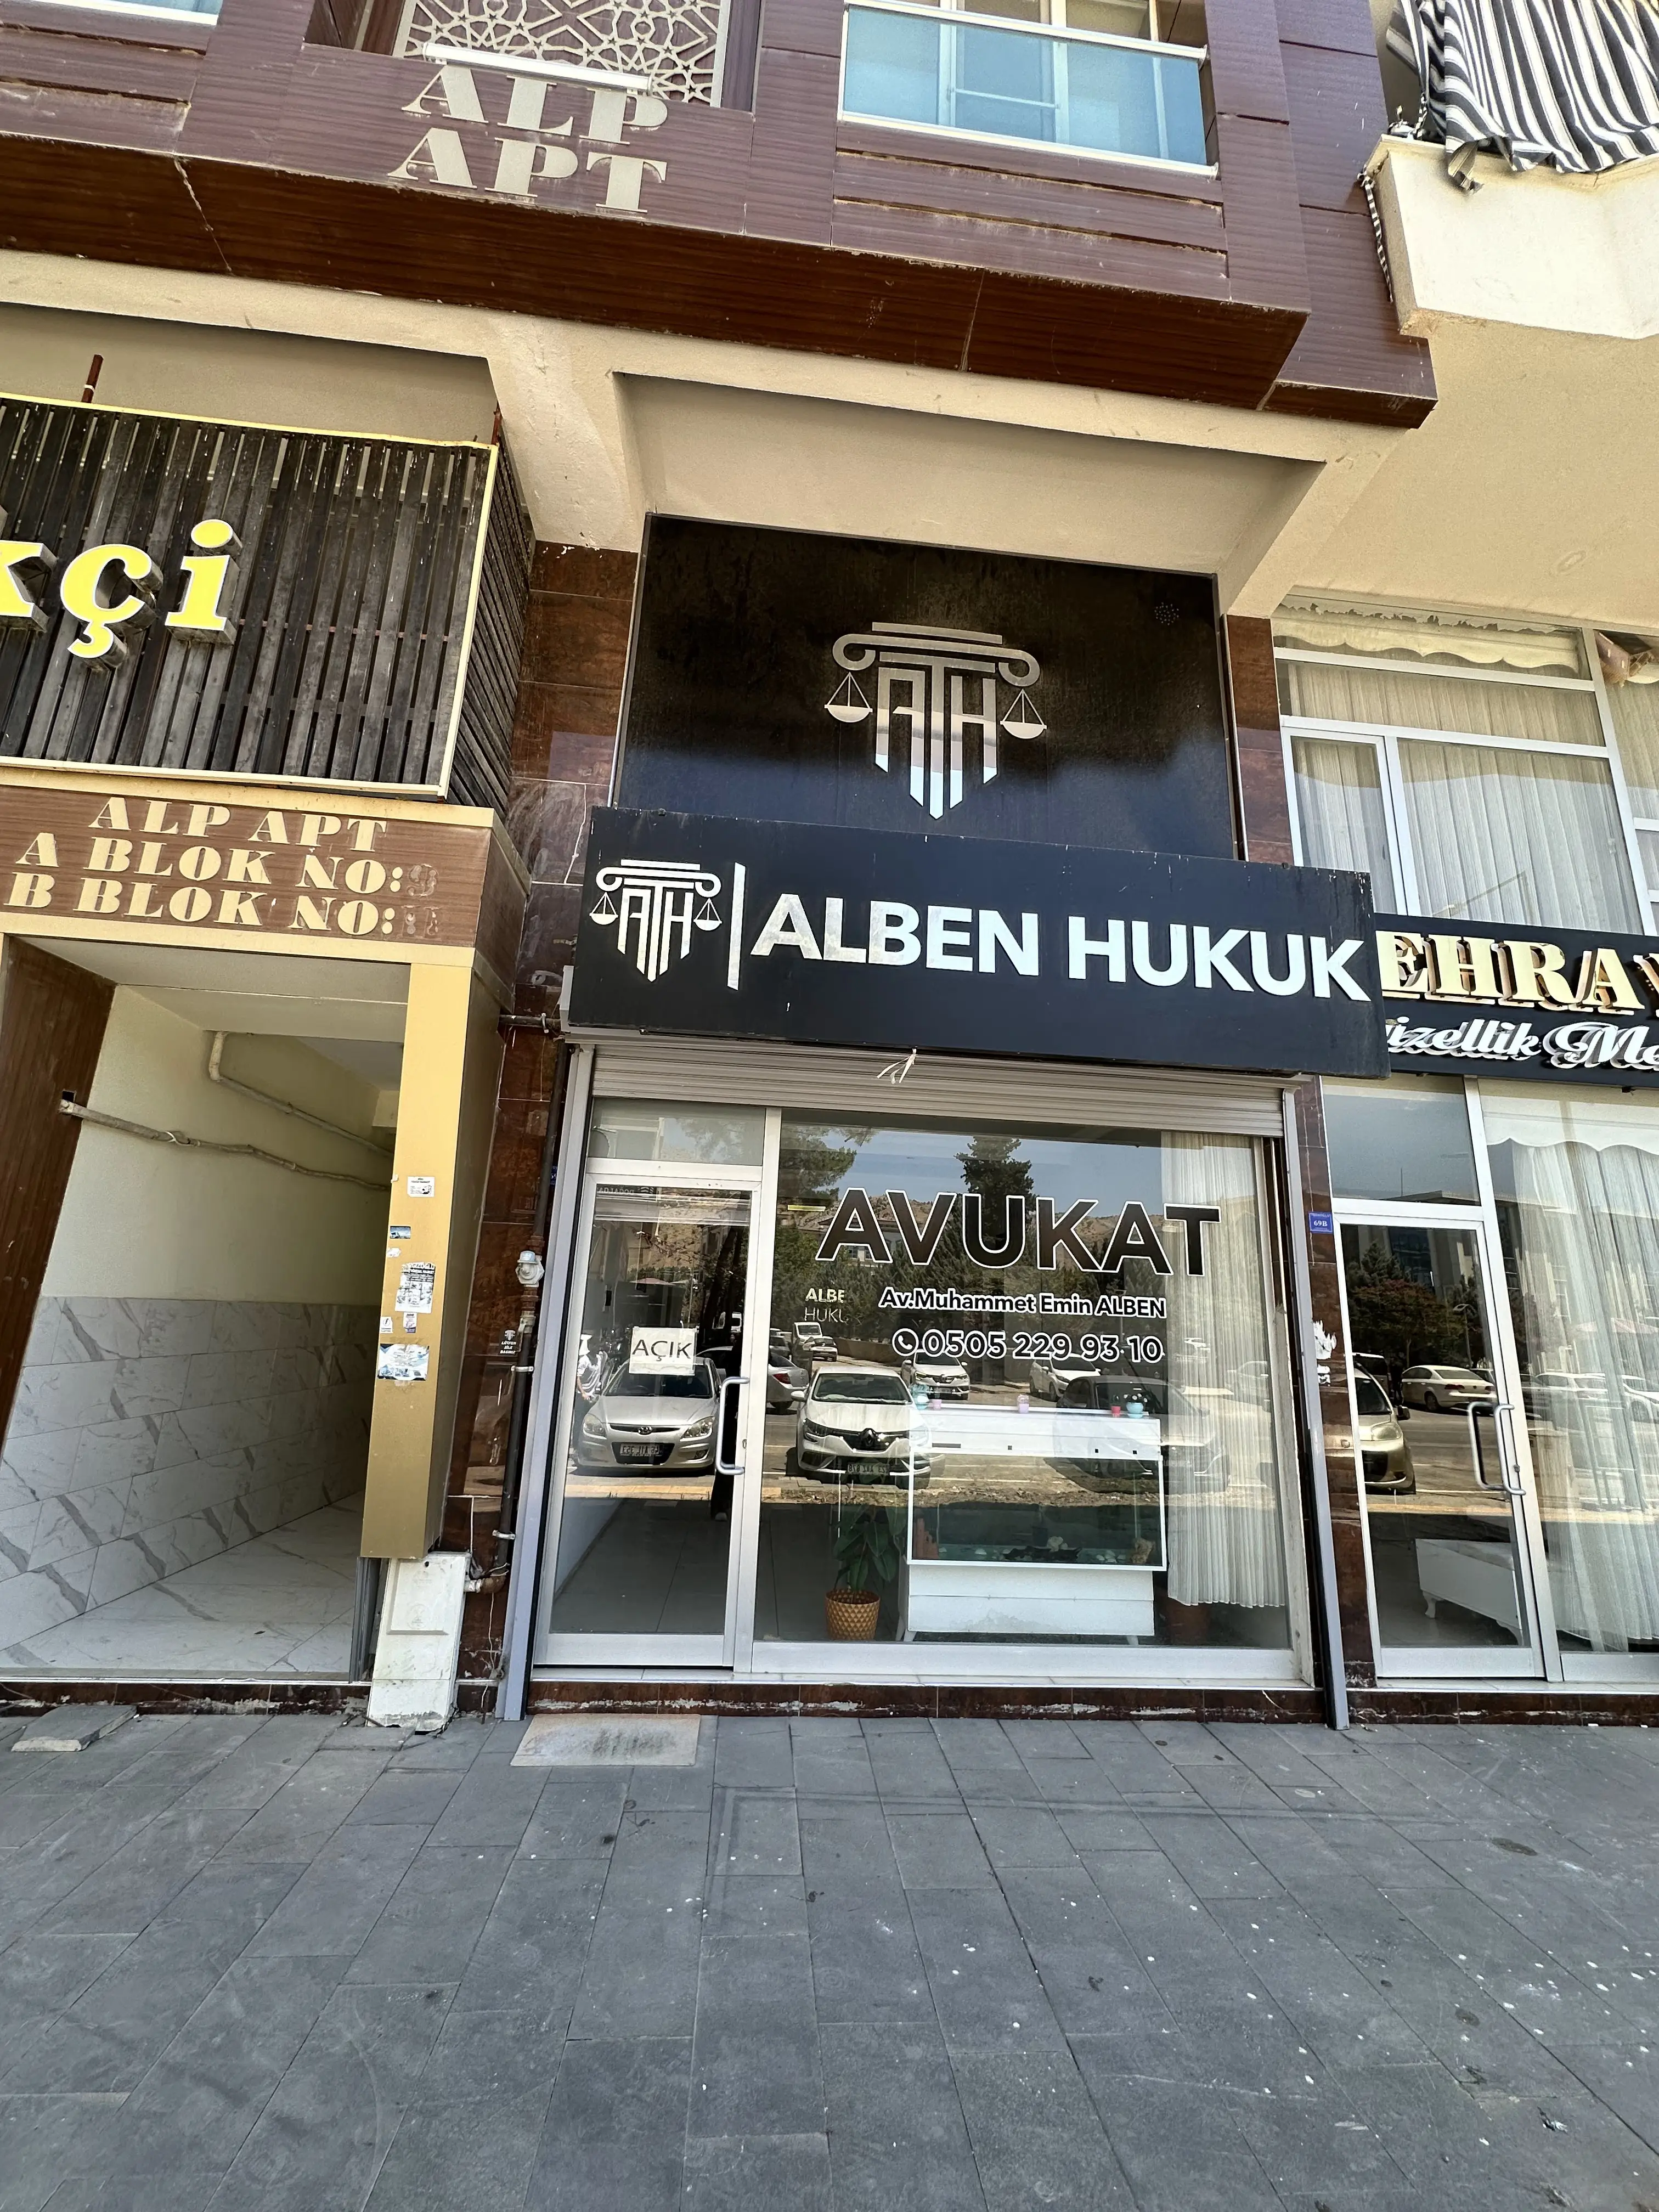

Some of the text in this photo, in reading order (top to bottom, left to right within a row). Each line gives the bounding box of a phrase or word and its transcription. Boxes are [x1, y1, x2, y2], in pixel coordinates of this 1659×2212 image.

[402, 65, 668, 144] ALP
[387, 127, 667, 213] APT
[88, 797, 387, 852] ALP APT
[15, 832, 59, 867] A
[83, 837, 275, 884] BLOK
[3, 872, 55, 909] B
[73, 878, 267, 927] BLOK
[750, 893, 1372, 1002] ALBEN HUKUK
[1375, 930, 1659, 1014] EHRA
[815, 1187, 1221, 1277] AVUKAT
[878, 1286, 1167, 1318] Av.Muhammet Emin ALBEN
[632, 1339, 692, 1362] AÇIK
[922, 1328, 1164, 1364] 0505 229 93 10
